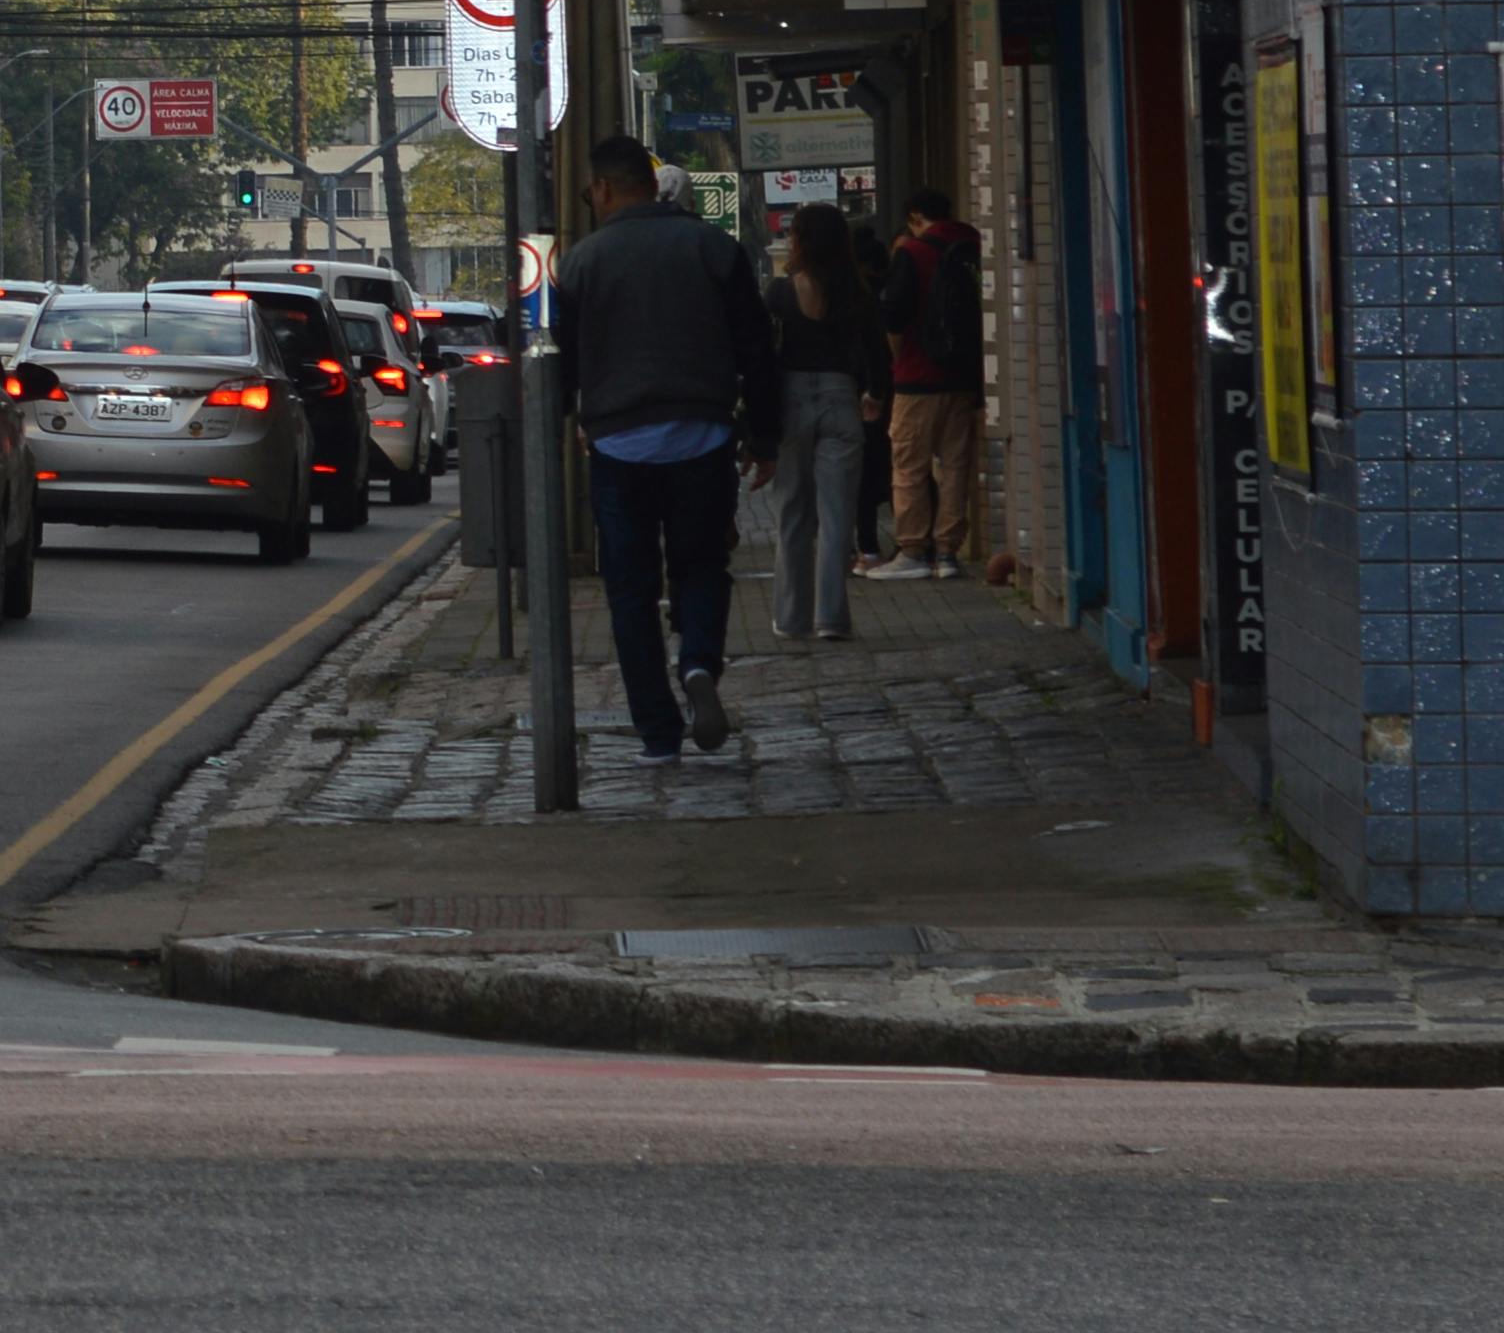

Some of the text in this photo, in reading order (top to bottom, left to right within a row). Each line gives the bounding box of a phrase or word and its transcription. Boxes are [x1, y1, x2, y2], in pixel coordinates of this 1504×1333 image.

[464, 47, 501, 62] Dias
[475, 68, 496, 82] 7h
[153, 87, 209, 98] ÁREA CALMA
[107, 97, 136, 117] 40
[155, 109, 208, 118] VELOCIDADE
[477, 111, 497, 126] 7h
[164, 121, 198, 131] MÁXIMA
[1235, 449, 1264, 653] CELULAR
